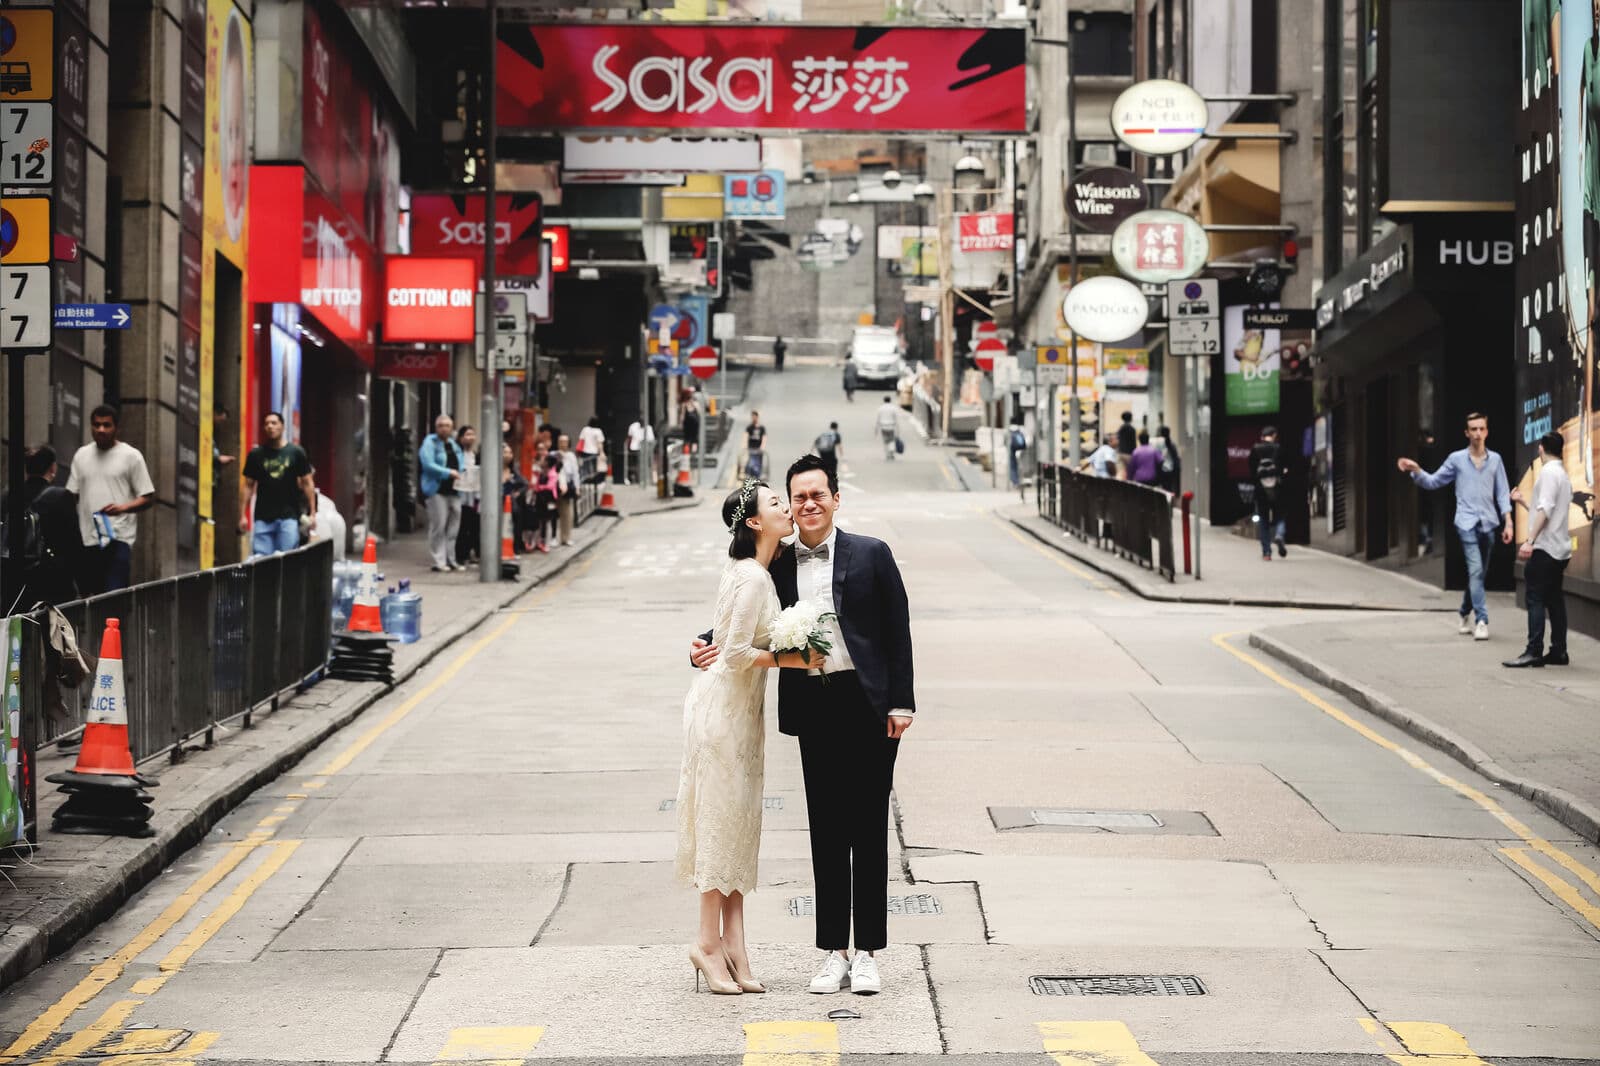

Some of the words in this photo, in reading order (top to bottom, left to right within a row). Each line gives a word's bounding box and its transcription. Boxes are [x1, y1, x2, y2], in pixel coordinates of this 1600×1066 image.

[590, 44, 773, 114] Sasa
[791, 55, 910, 114] 莎莎
[1522, 56, 1552, 111] NOT
[10, 108, 29, 134] 7
[11, 153, 45, 179] 12
[1074, 183, 1141, 199] Watson's
[1075, 199, 1114, 214] Wine
[1522, 206, 1553, 255] FOR
[1439, 239, 1514, 266] HUB
[10, 273, 28, 300] 7
[387, 288, 448, 307] COTTON
[450, 288, 473, 307] ON
[1072, 303, 1139, 315] PANDORA
[10, 315, 29, 342] 7
[1201, 321, 1209, 332] 7
[508, 336, 516, 347] 7
[1202, 340, 1217, 352] 12
[508, 355, 522, 367] 12
